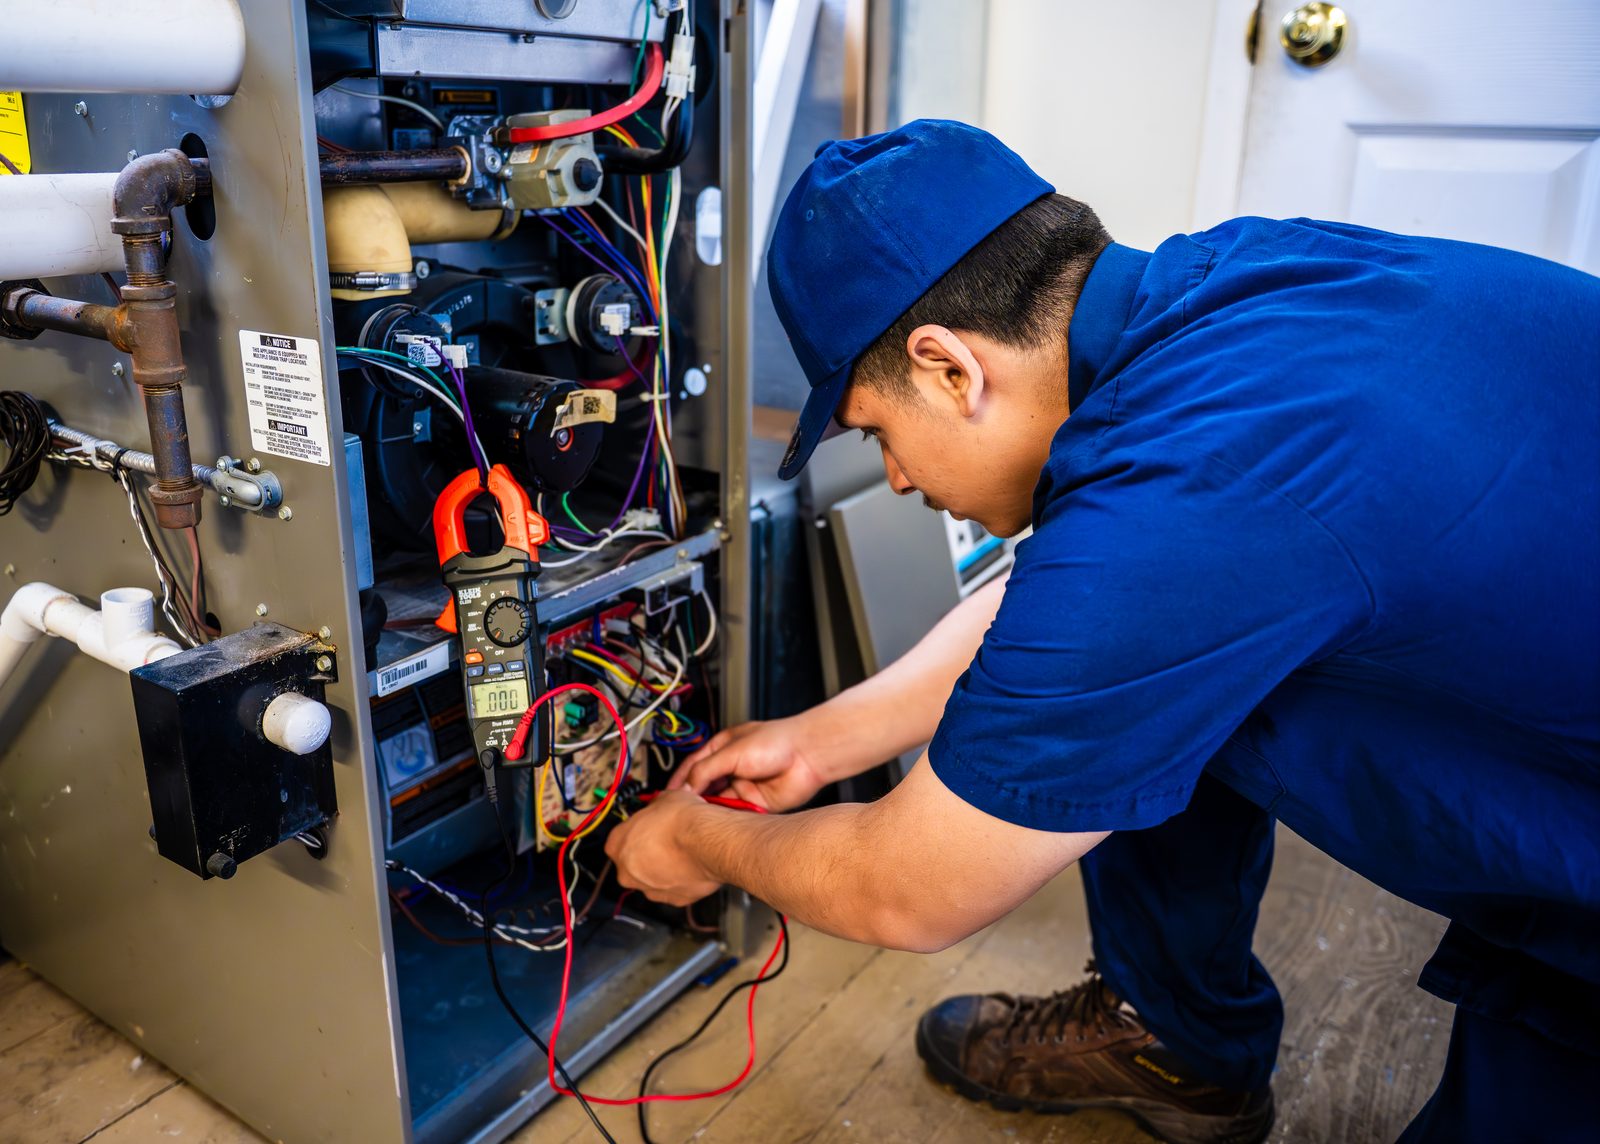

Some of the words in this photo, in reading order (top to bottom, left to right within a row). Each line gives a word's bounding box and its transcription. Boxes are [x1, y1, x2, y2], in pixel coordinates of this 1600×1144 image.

[272, 338, 291, 349] NOTICE
[282, 351, 298, 359] EQUIPPED
[277, 422, 306, 435] IMPORTANT
[267, 441, 285, 449] INSTALLATION
[286, 445, 306, 453] INSTRUCTIONS
[458, 587, 481, 596] KLEIN
[460, 591, 482, 600] TOOLS
